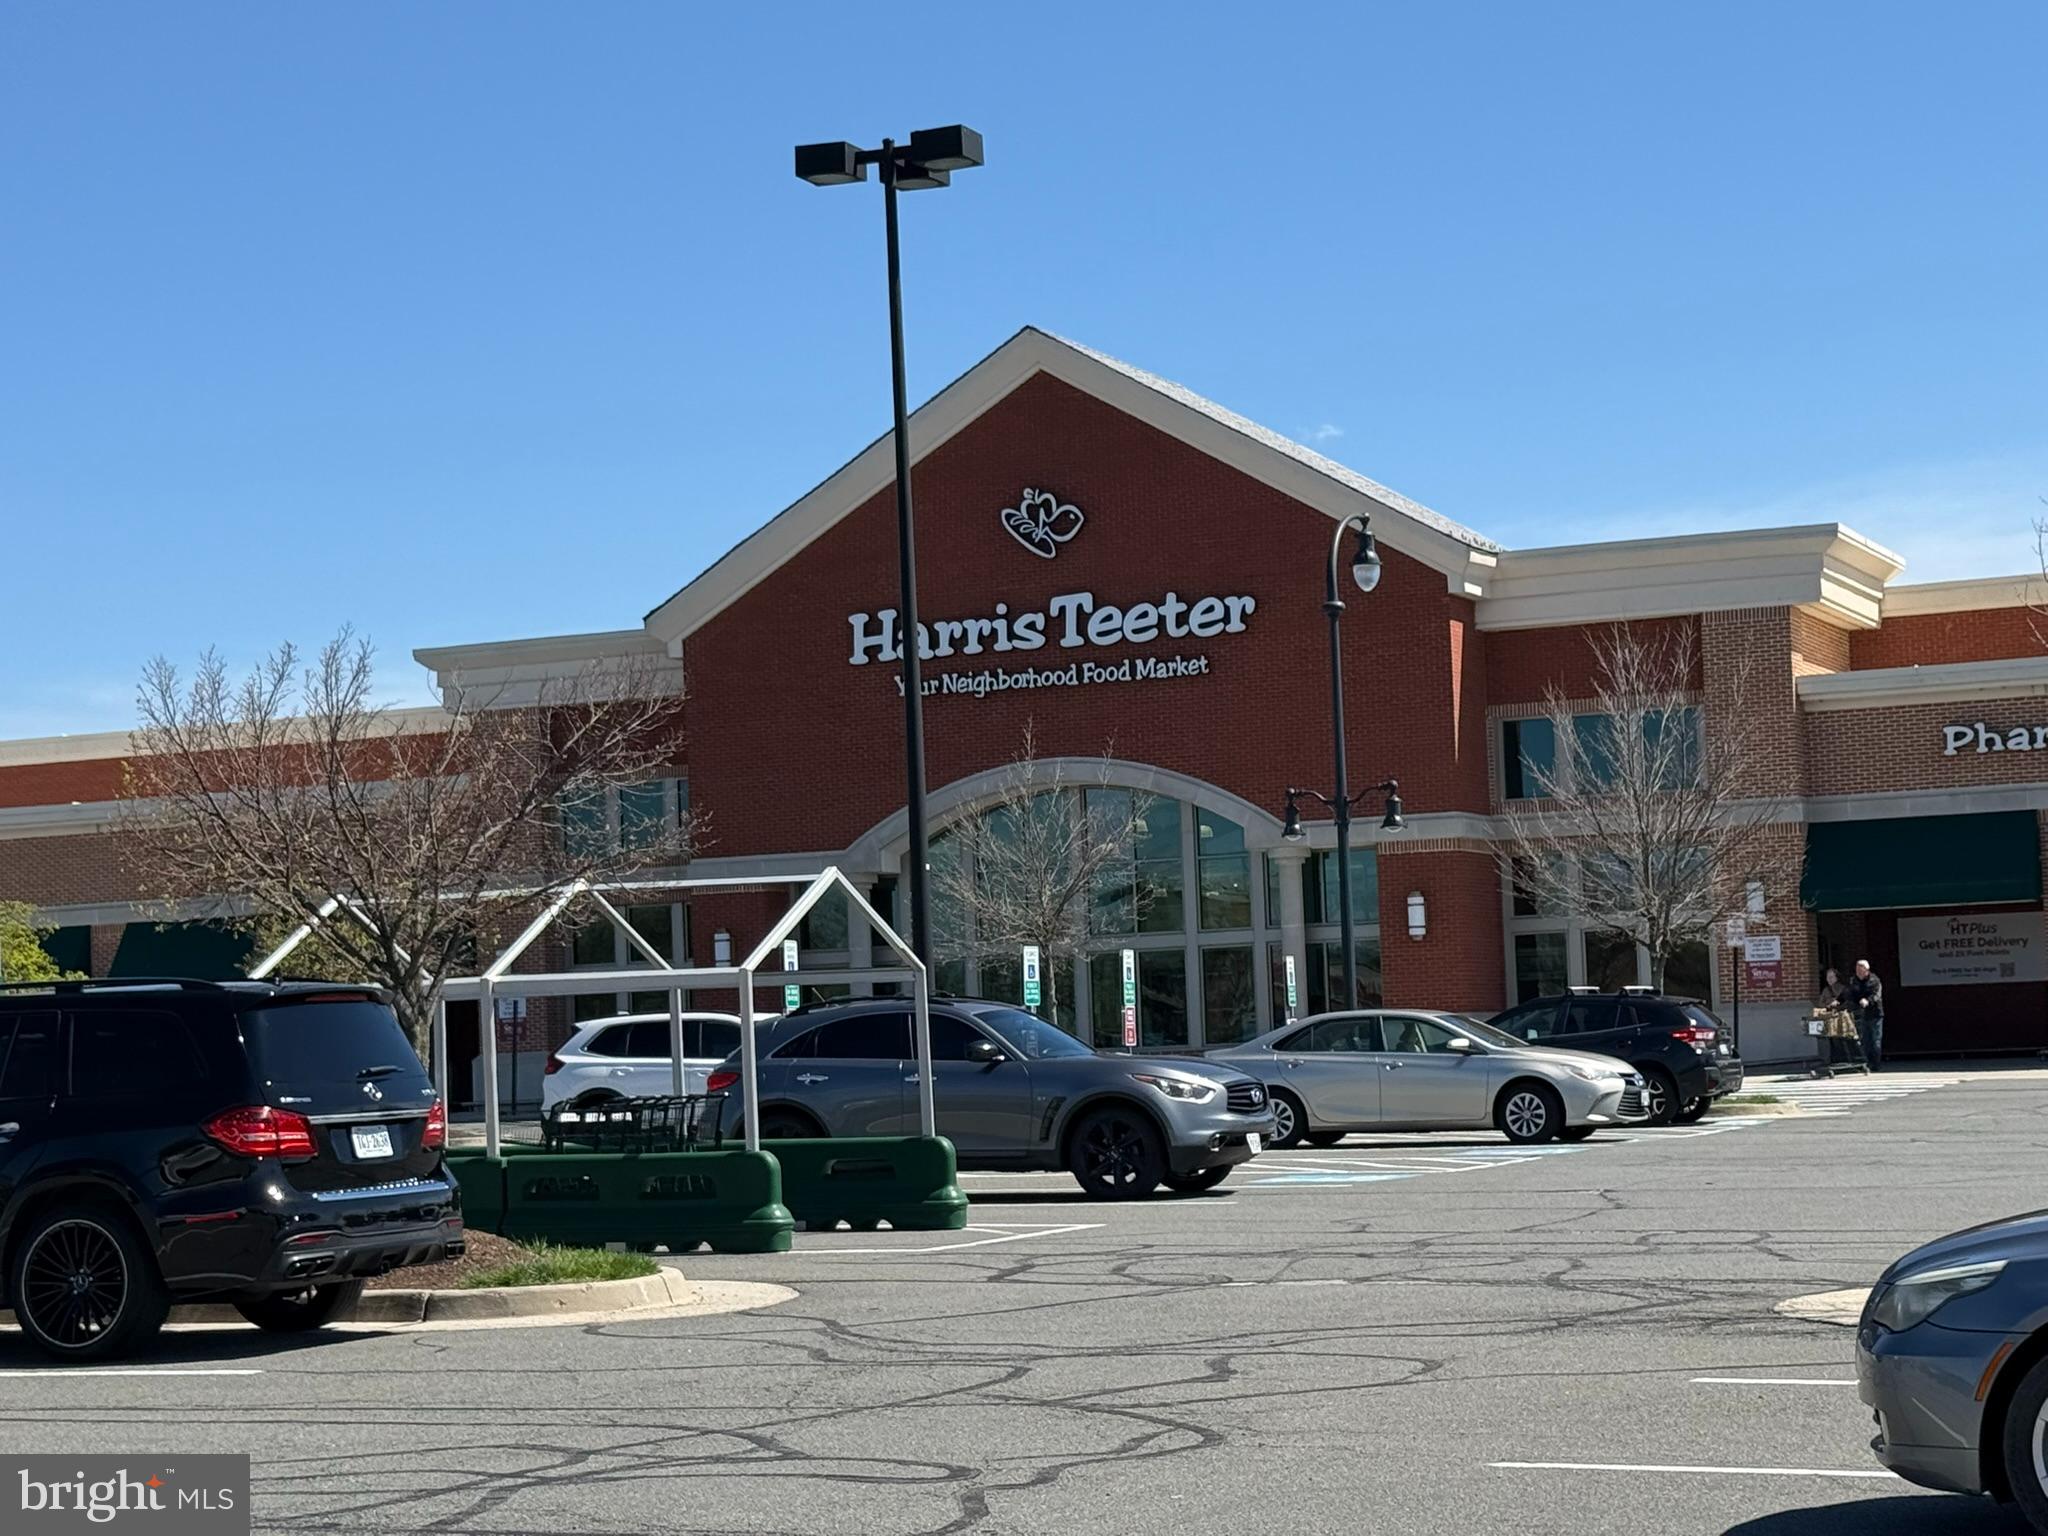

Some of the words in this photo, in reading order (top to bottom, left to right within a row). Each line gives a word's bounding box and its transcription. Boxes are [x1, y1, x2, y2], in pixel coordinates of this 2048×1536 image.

[848, 603, 1046, 665] Harris
[1050, 592, 1256, 648] Teeter
[894, 674, 939, 697] Yur
[942, 664, 1078, 698] Neighborhood
[1082, 660, 1131, 684] Food
[1135, 655, 1210, 681] Market
[1943, 722, 2048, 756] Phar
[1918, 940, 1941, 950] Get
[1944, 937, 1976, 949] FREE
[1978, 936, 2029, 949] Delivery
